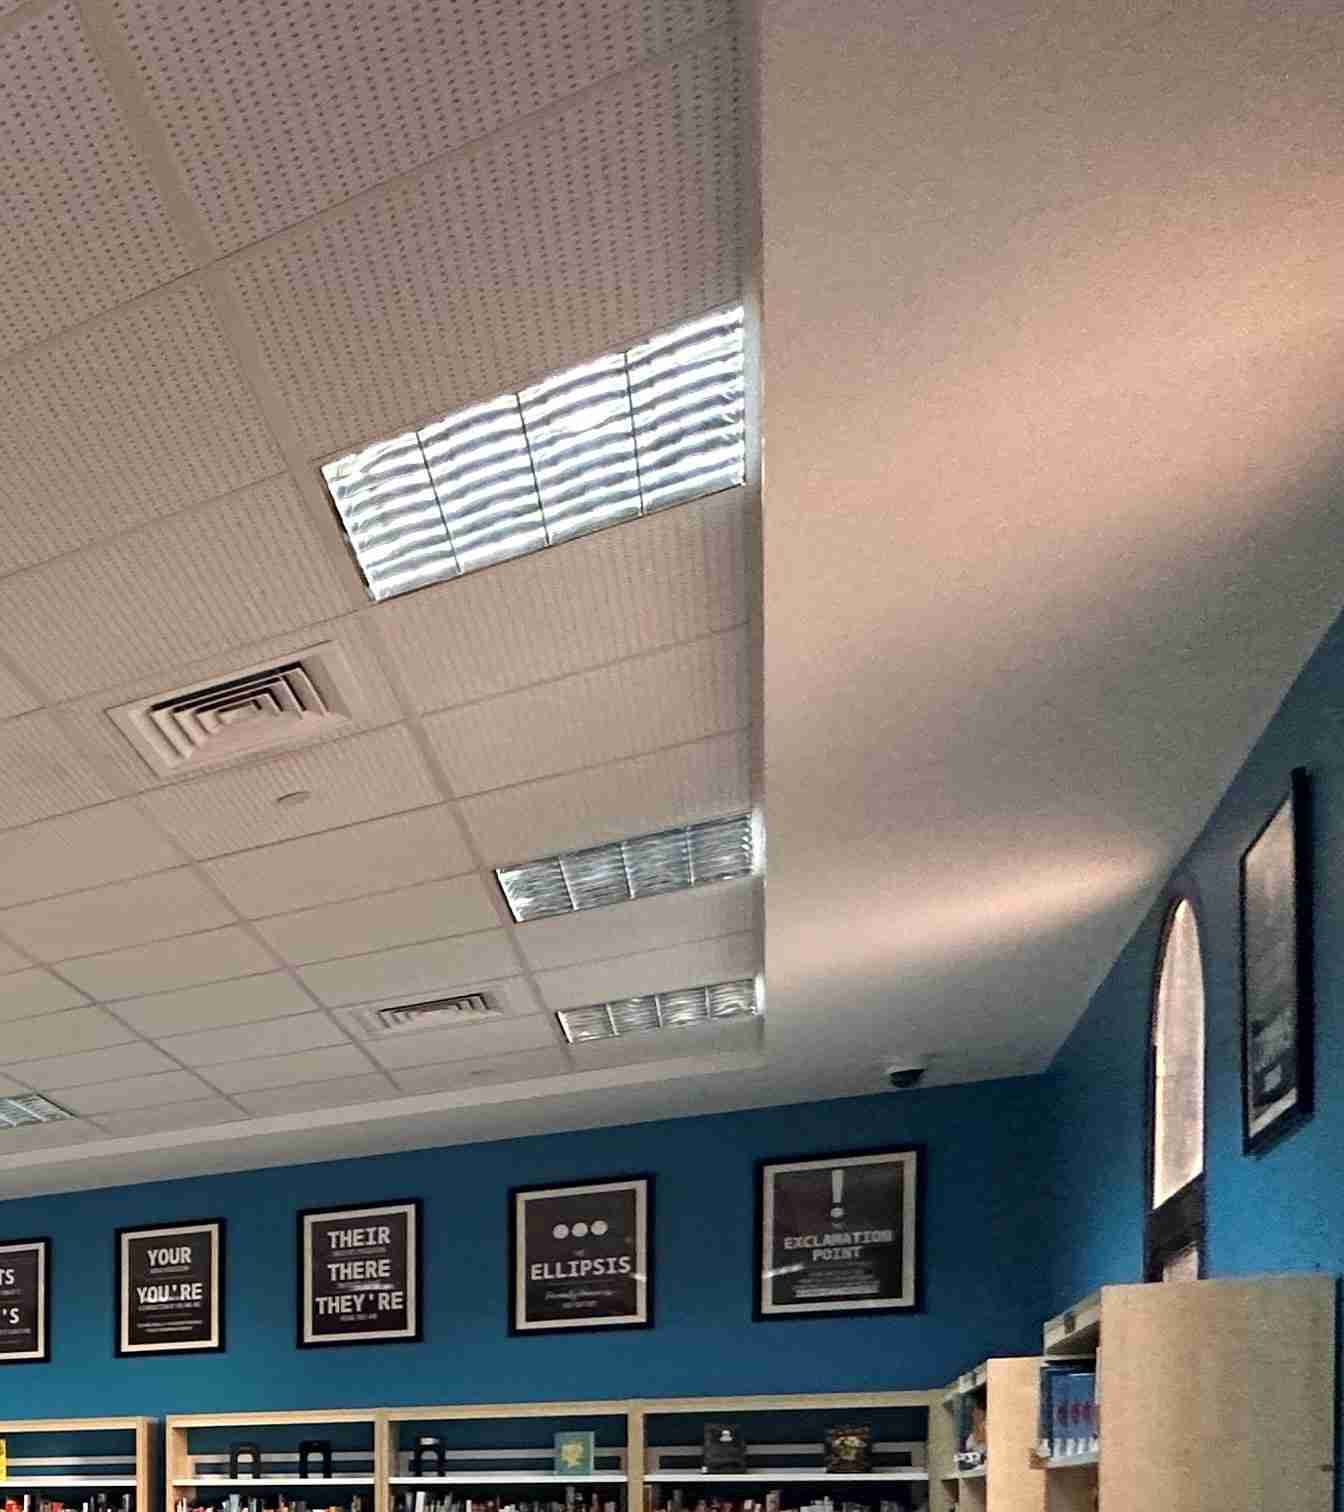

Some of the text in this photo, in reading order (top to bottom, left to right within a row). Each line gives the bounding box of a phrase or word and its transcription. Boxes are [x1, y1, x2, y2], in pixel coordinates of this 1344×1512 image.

[327, 1226, 391, 1249] THEIR
[783, 1229, 894, 1250] EXCLAMATION
[147, 1246, 192, 1267] YOUR
[812, 1246, 862, 1261] POINT
[327, 1259, 391, 1281] THERE
[531, 1256, 632, 1280] ELLIPSIS
[136, 1283, 203, 1304] YOU'RE
[315, 1291, 404, 1315] THEY'RE
